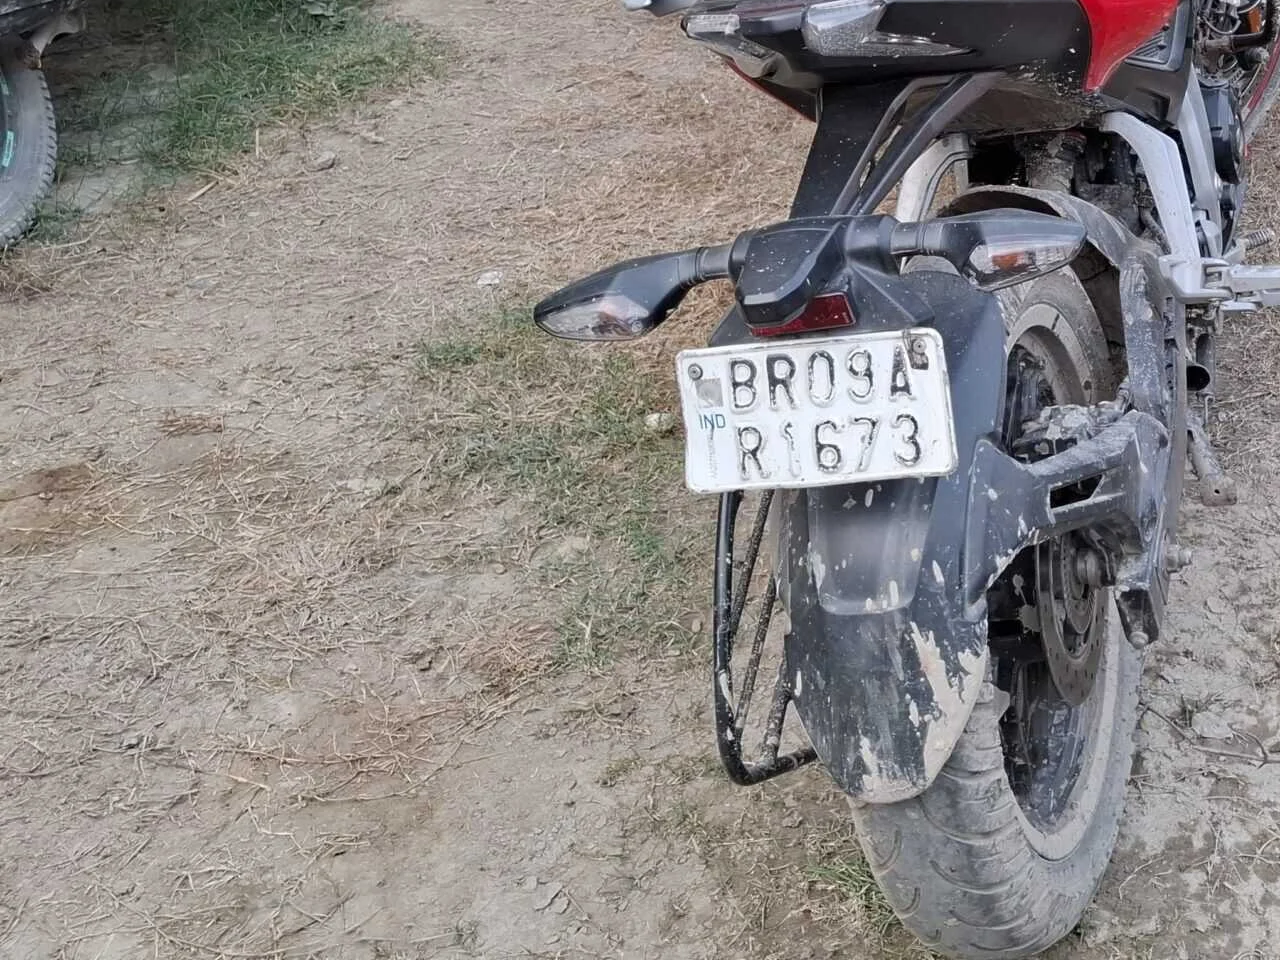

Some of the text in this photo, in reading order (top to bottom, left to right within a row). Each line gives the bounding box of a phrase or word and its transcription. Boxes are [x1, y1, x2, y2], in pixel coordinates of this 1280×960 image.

[730, 343, 917, 414] BR09A
[700, 413, 727, 430] IND
[737, 413, 922, 480] R1673
